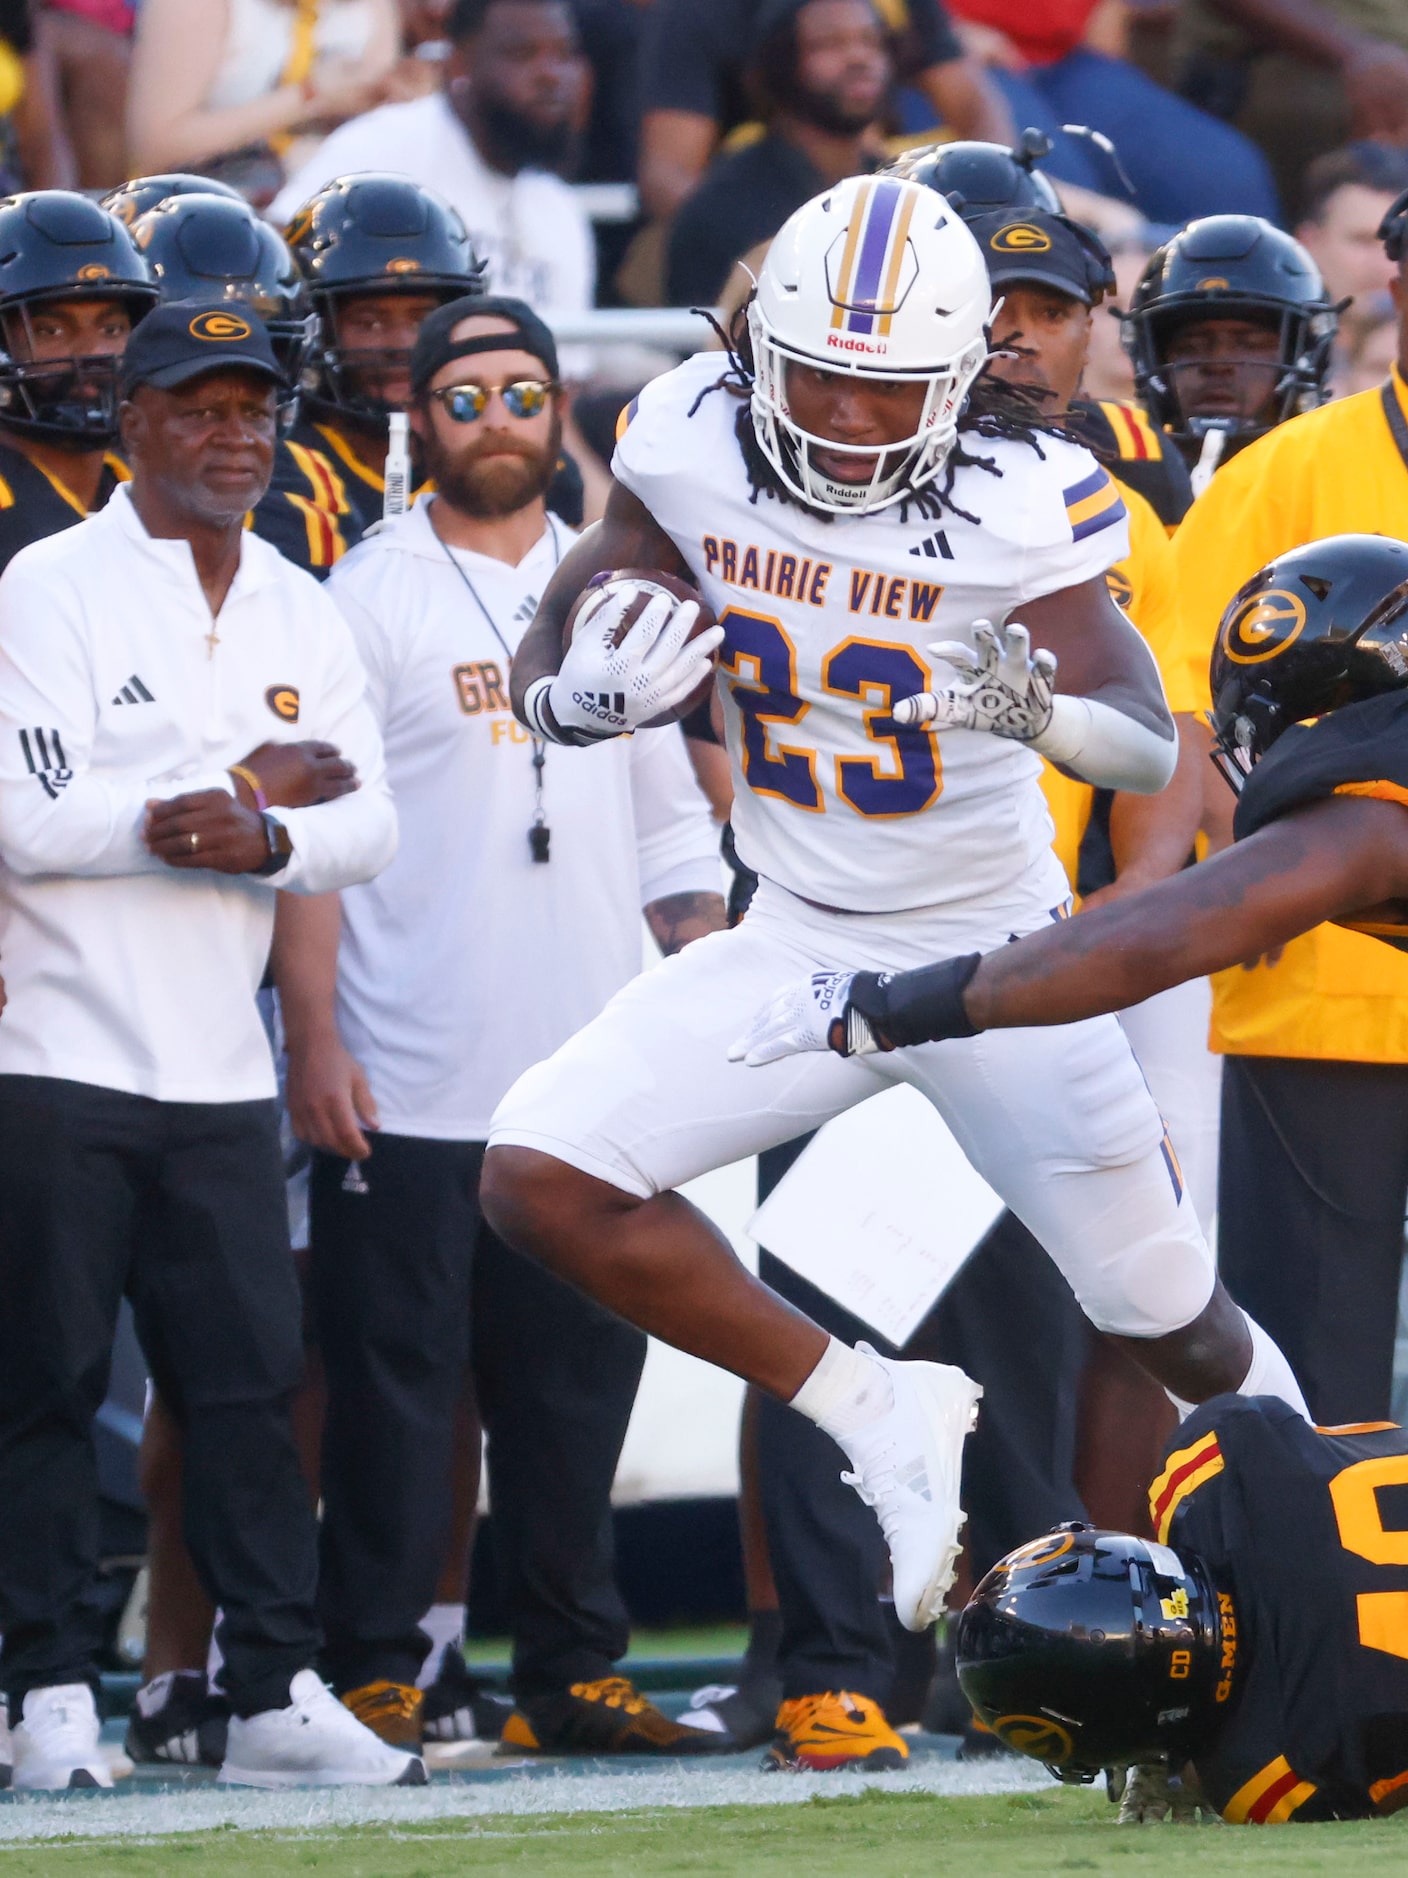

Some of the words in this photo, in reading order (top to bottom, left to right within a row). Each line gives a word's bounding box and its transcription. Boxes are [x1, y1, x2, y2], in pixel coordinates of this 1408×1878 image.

[190, 311, 252, 342] G
[826, 484, 867, 499] Riddell
[703, 534, 832, 608] PRAIRIE
[848, 567, 945, 623] VIEW
[451, 658, 513, 716] GR
[572, 690, 629, 727] adidas
[717, 604, 945, 819] 23
[820, 971, 851, 1010] adida
[1169, 1650, 1192, 1679] CD
[1215, 1591, 1237, 1702] G-MEN
